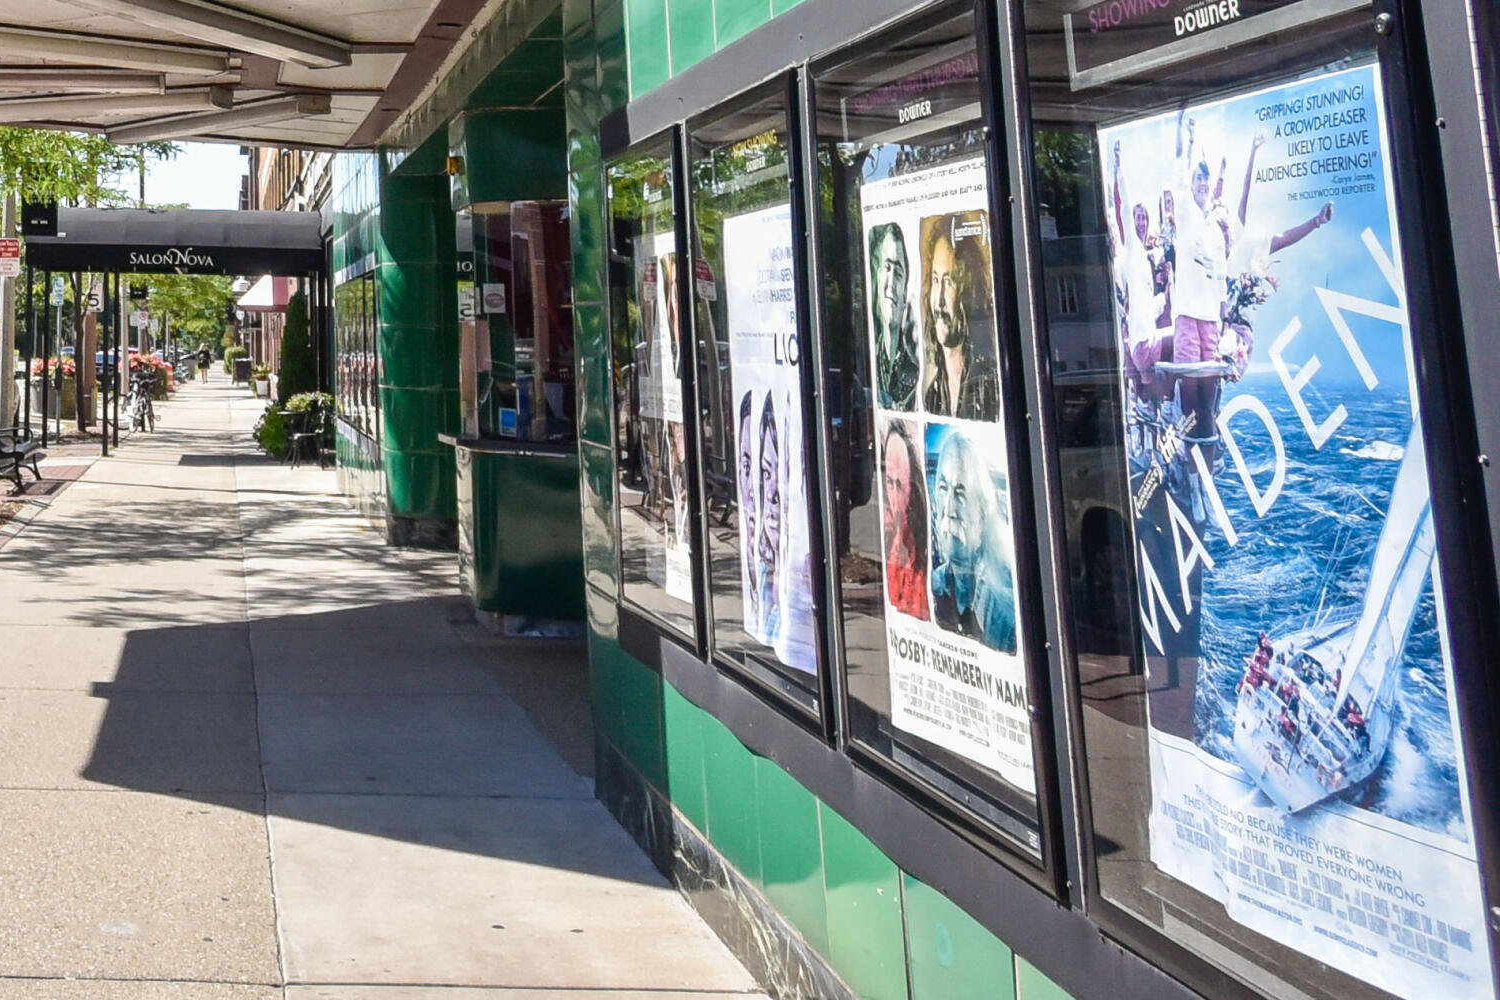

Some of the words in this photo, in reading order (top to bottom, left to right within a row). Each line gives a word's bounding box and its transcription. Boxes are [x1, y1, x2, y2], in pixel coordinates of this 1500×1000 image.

[898, 100, 932, 124] DOWNER
[1306, 85, 1365, 111] STUNNING!
[1274, 124, 1282, 139] A
[1283, 107, 1367, 137] CROWD-PLEASER
[1288, 138, 1316, 157] LIKELY
[1318, 136, 1332, 151] TO
[1335, 129, 1369, 149] LEAVE
[1255, 162, 1308, 184] AUDIENCES
[1299, 187, 1340, 200] HOLLYWOOD
[1341, 183, 1376, 196] REPORTER
[130, 252, 173, 265] SALON
[167, 247, 214, 266] NOVA
[1140, 227, 1408, 657] MAIDEN
[931, 648, 984, 690] REMEMBER
[1229, 808, 1245, 824] NO
[1247, 815, 1292, 842] BECAUSE
[1293, 831, 1321, 851] THEY
[1322, 842, 1353, 864] WERE
[1355, 854, 1403, 882] WOMEN
[1243, 828, 1271, 849] THAT
[1272, 839, 1314, 865] PROVED
[1316, 855, 1373, 888] EVERYONE
[1374, 876, 1426, 908] WRONG
